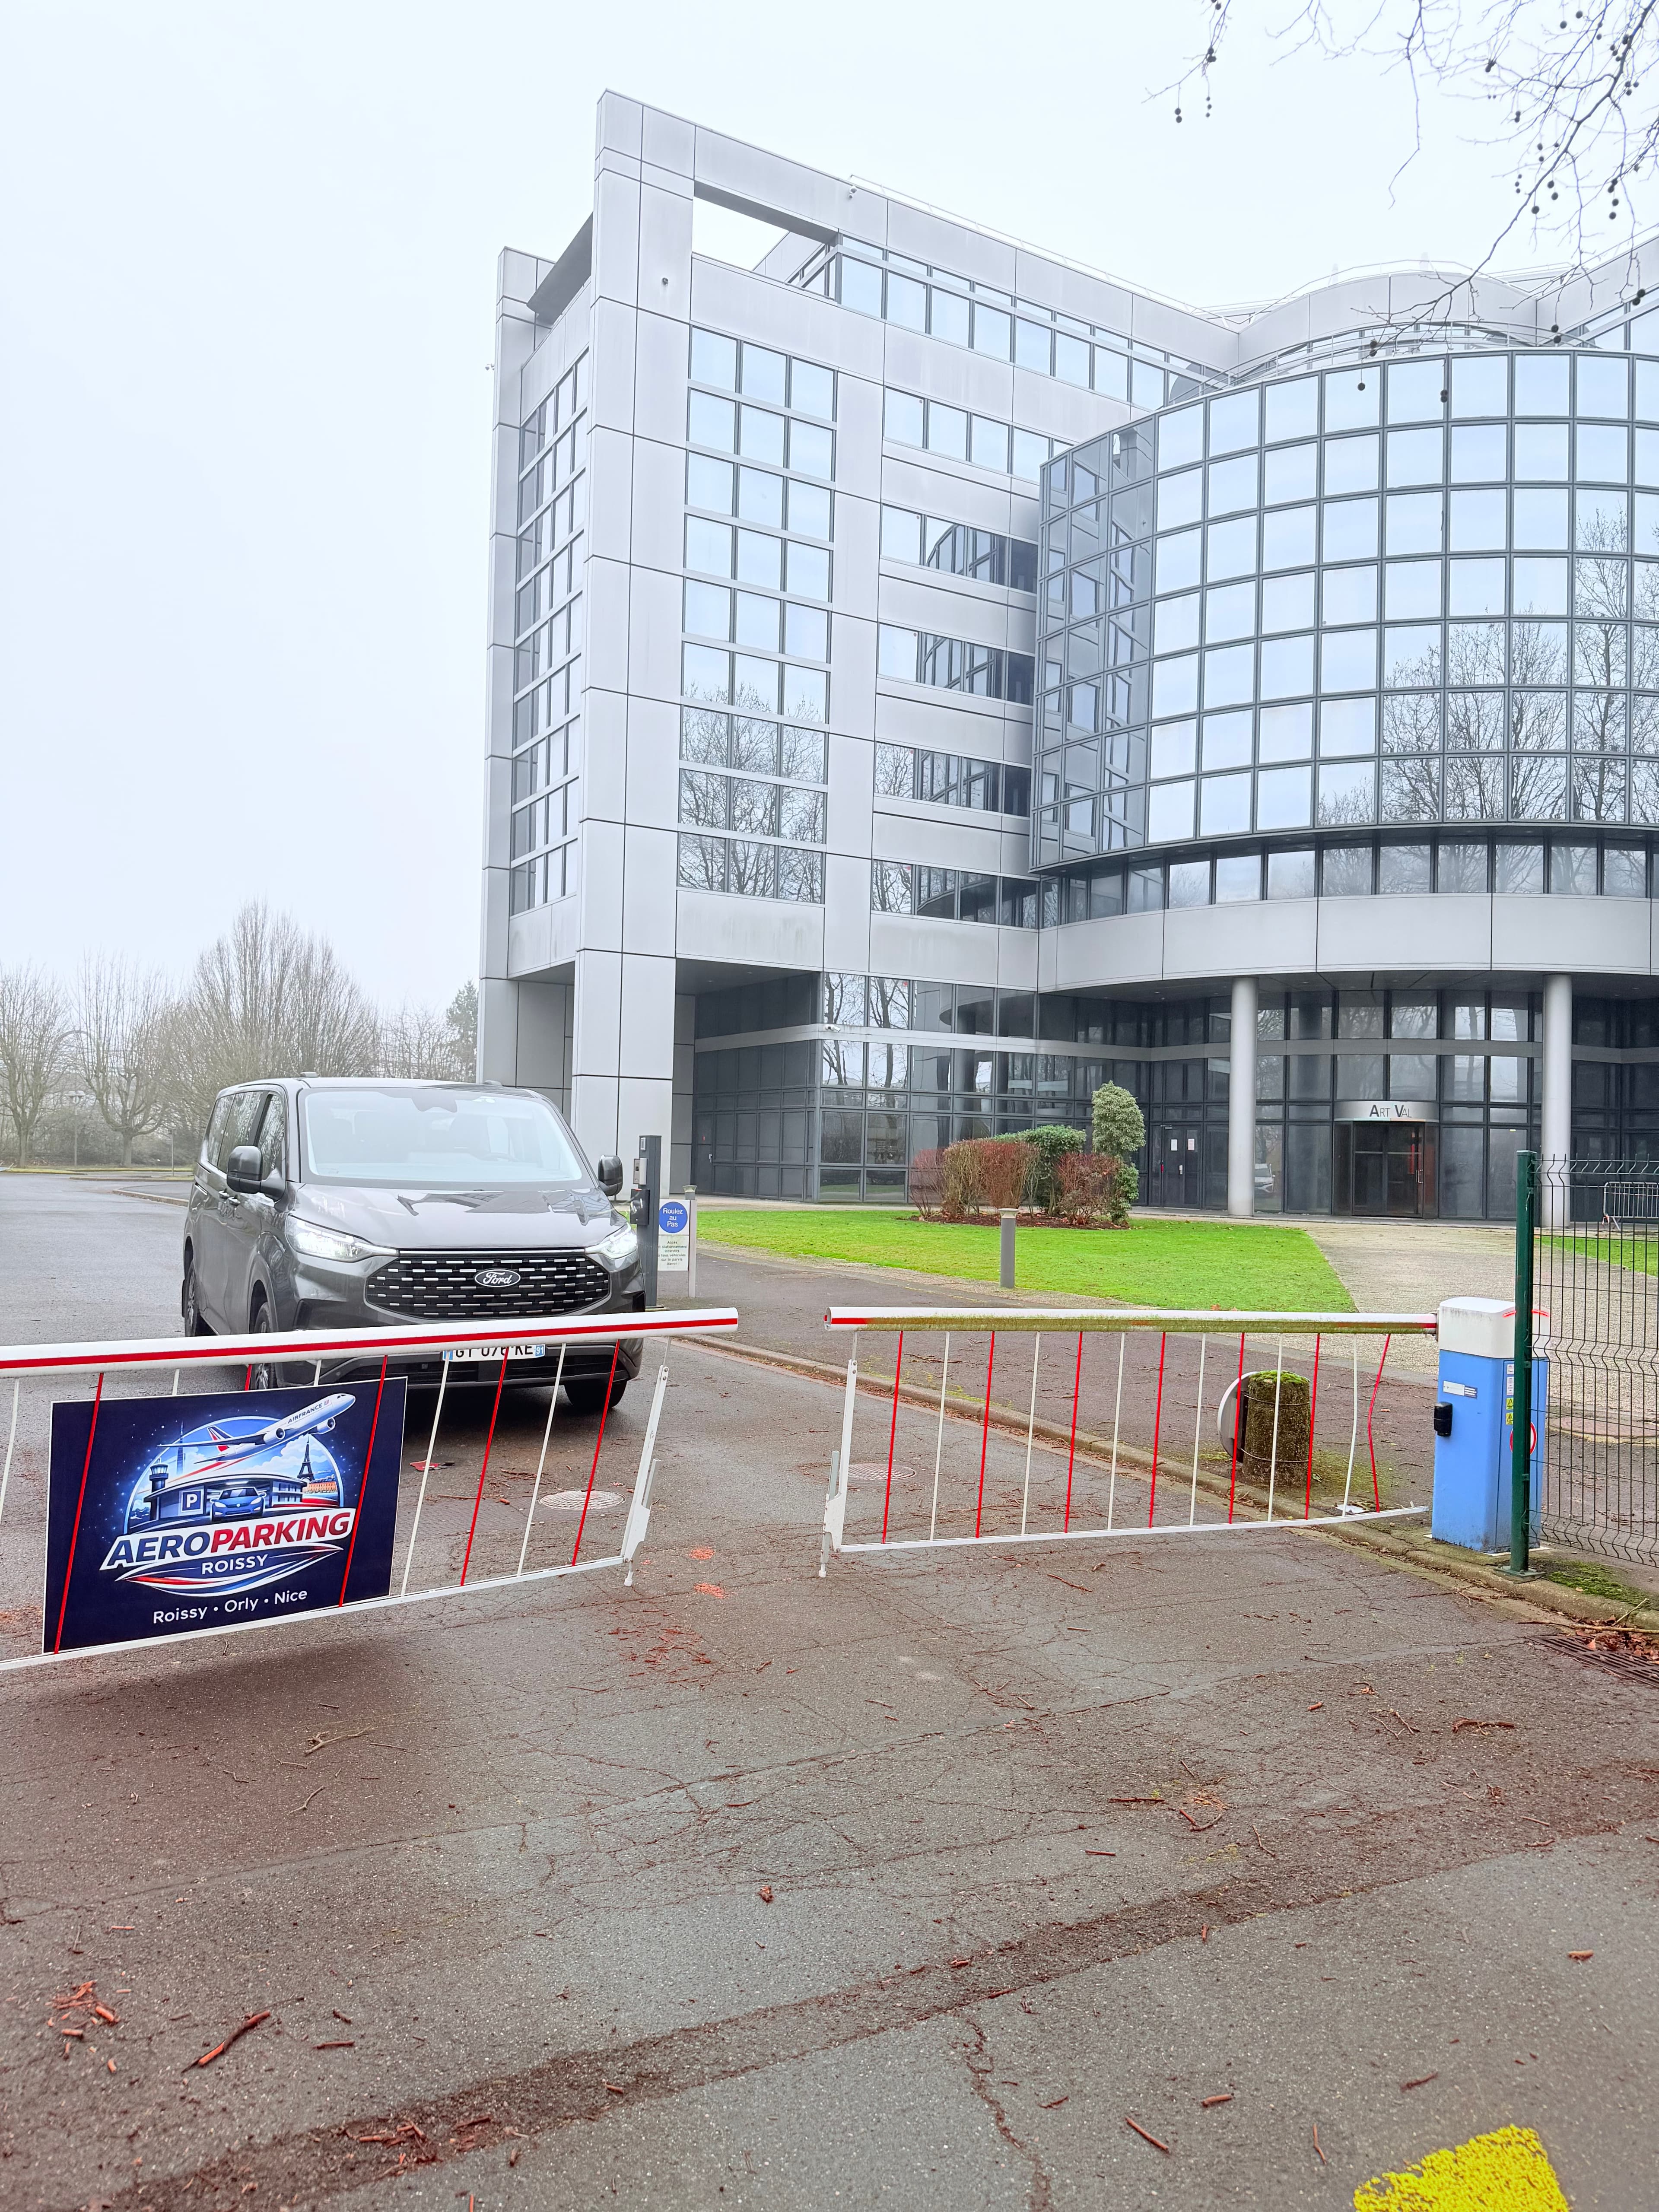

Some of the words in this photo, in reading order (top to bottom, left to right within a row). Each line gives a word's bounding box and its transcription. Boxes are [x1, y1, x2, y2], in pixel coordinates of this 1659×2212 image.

[483, 1271, 513, 1284] Ford
[536, 1346, 543, 1354] 91
[186, 1494, 197, 1508] P
[108, 1512, 351, 1566] AEROPARKING
[202, 1554, 269, 1575] ROISSY
[153, 1606, 208, 1624] Roissy
[224, 1598, 259, 1612] Orly
[274, 1590, 308, 1604] Nice
